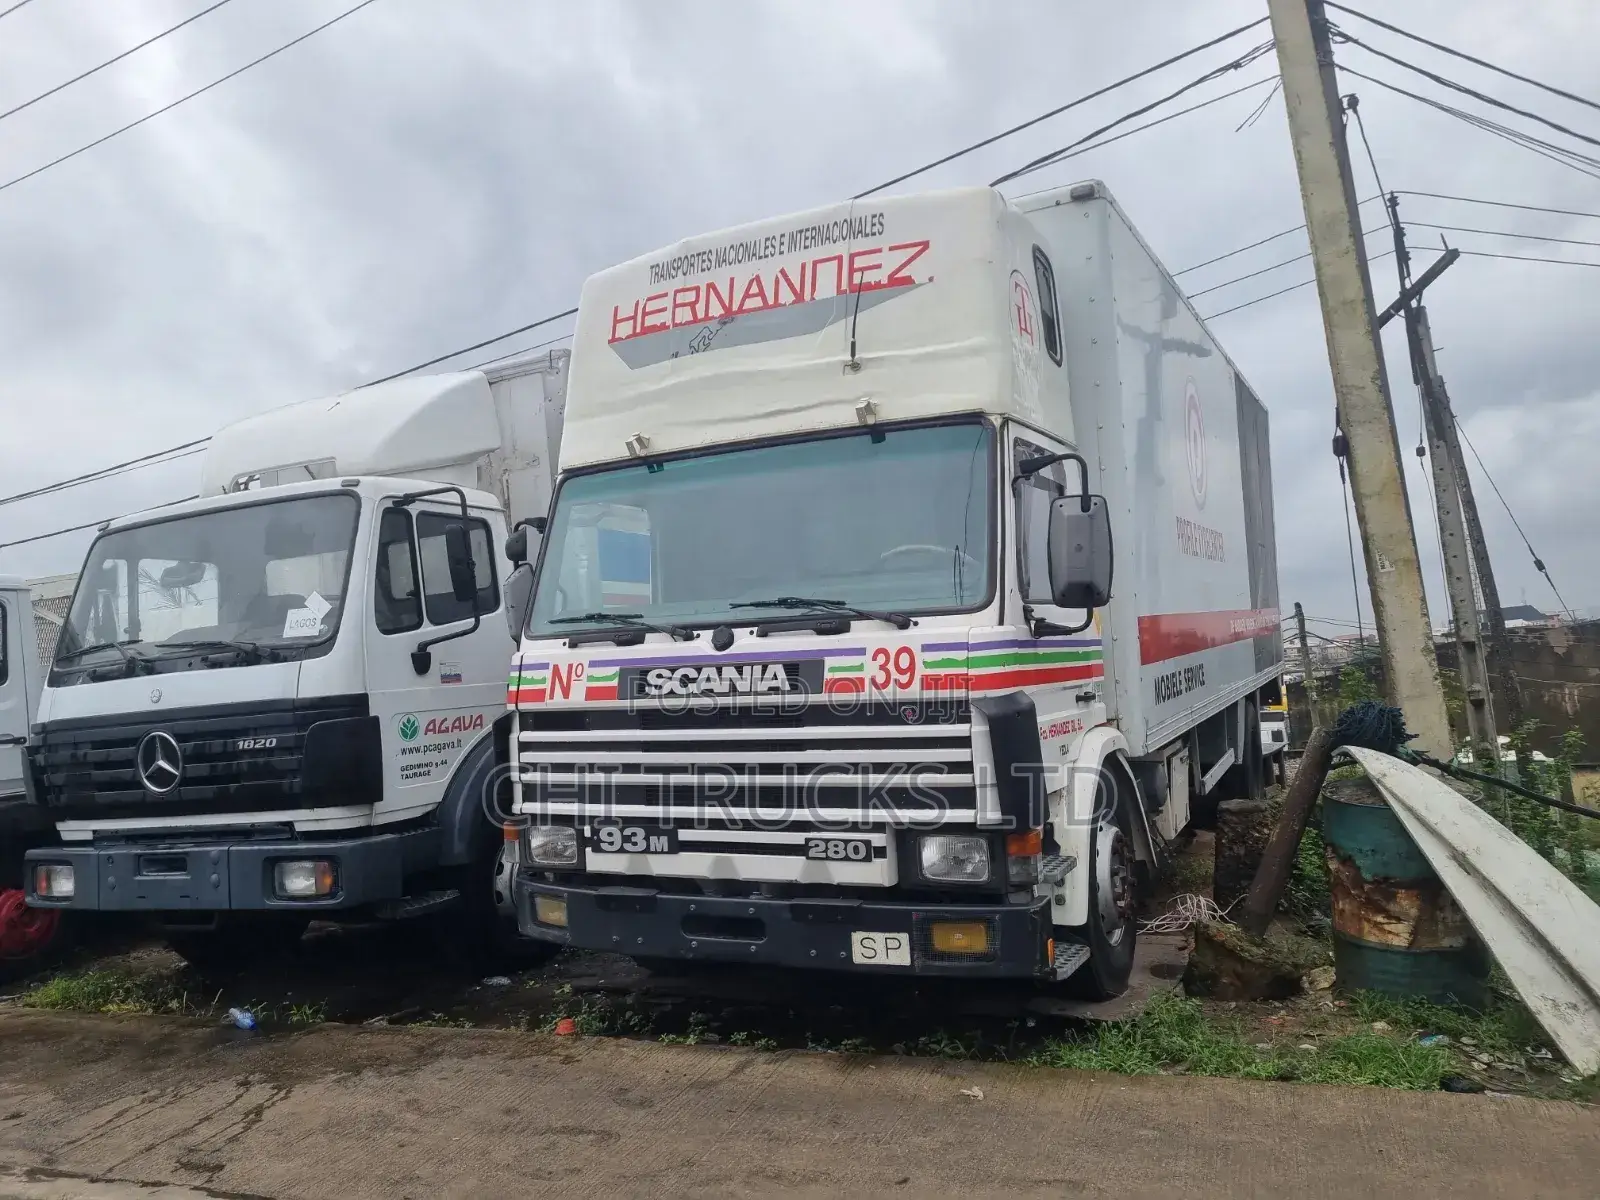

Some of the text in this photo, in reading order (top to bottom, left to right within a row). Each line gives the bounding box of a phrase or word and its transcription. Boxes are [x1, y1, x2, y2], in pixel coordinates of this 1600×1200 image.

[649, 212, 885, 286] TRANSPORTES NACIONALES E INTERNACIONALES
[289, 617, 318, 630] LAGOS
[645, 663, 792, 695] SCANIA
[871, 645, 917, 691] 39
[1154, 663, 1206, 706] MOBIELE SERVICE
[424, 713, 485, 736] AGAVA
[237, 737, 277, 750] 1820
[401, 738, 463, 756] www.pcagava.lt
[401, 761, 434, 772] GEDIMINO
[401, 769, 432, 780] TAURAGE
[807, 839, 867, 861] 280
